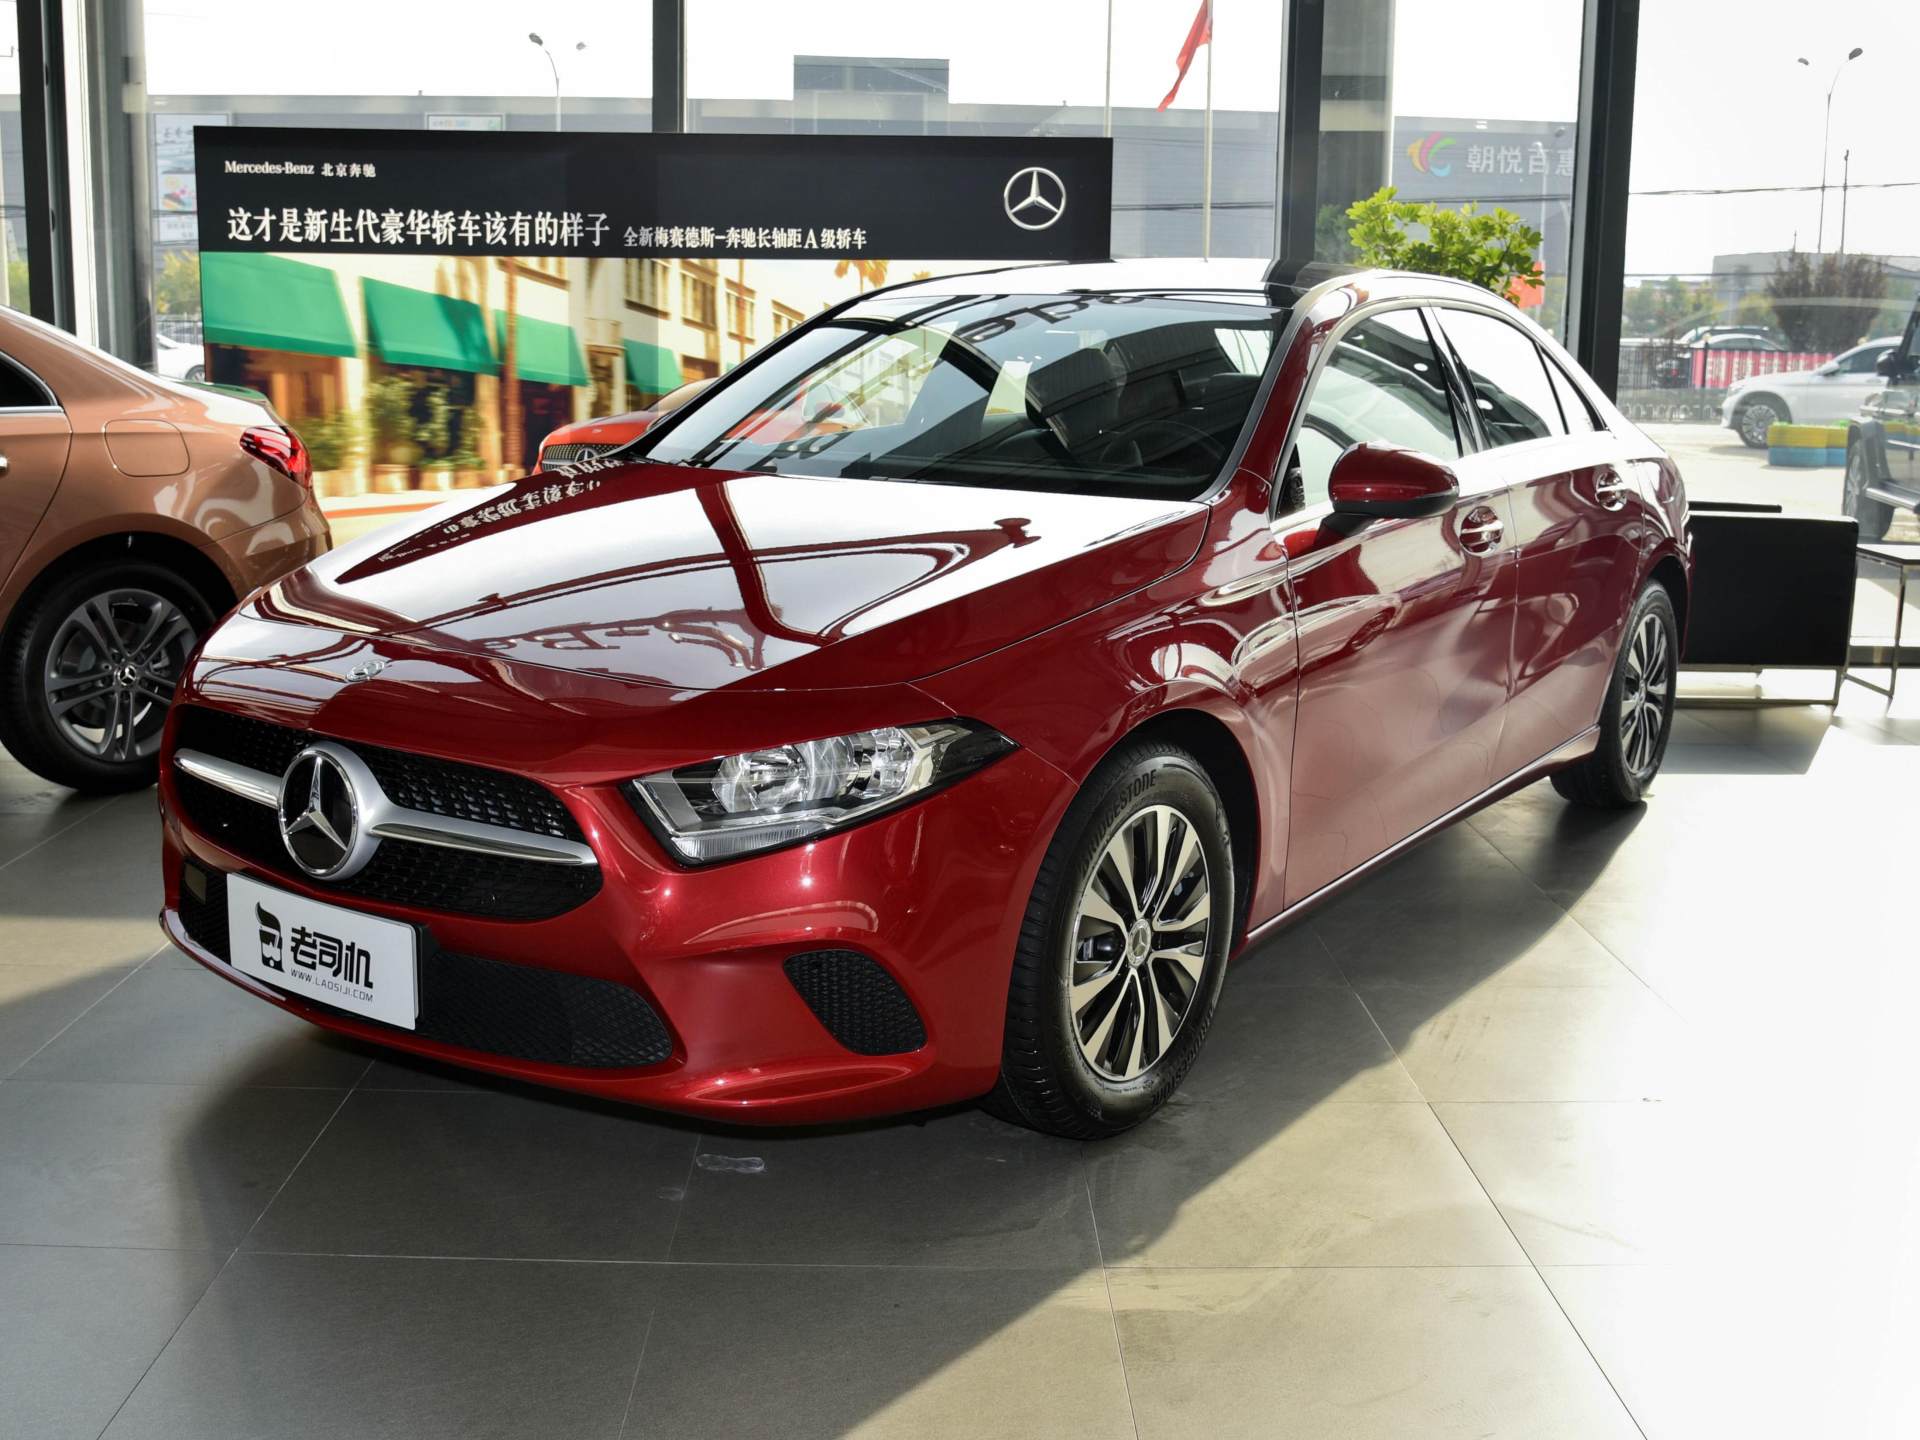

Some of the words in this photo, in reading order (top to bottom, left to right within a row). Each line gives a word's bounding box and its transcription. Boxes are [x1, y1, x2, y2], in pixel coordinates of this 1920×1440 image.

[224, 160, 315, 175] Mercedes-Benz
[321, 162, 377, 178] 北京奔驰
[226, 206, 611, 248] 这才是新生代豪华轿车该有的样子
[290, 926, 374, 989] 老司机
[290, 968, 374, 1002] WWW.LAOSIJI.COM
